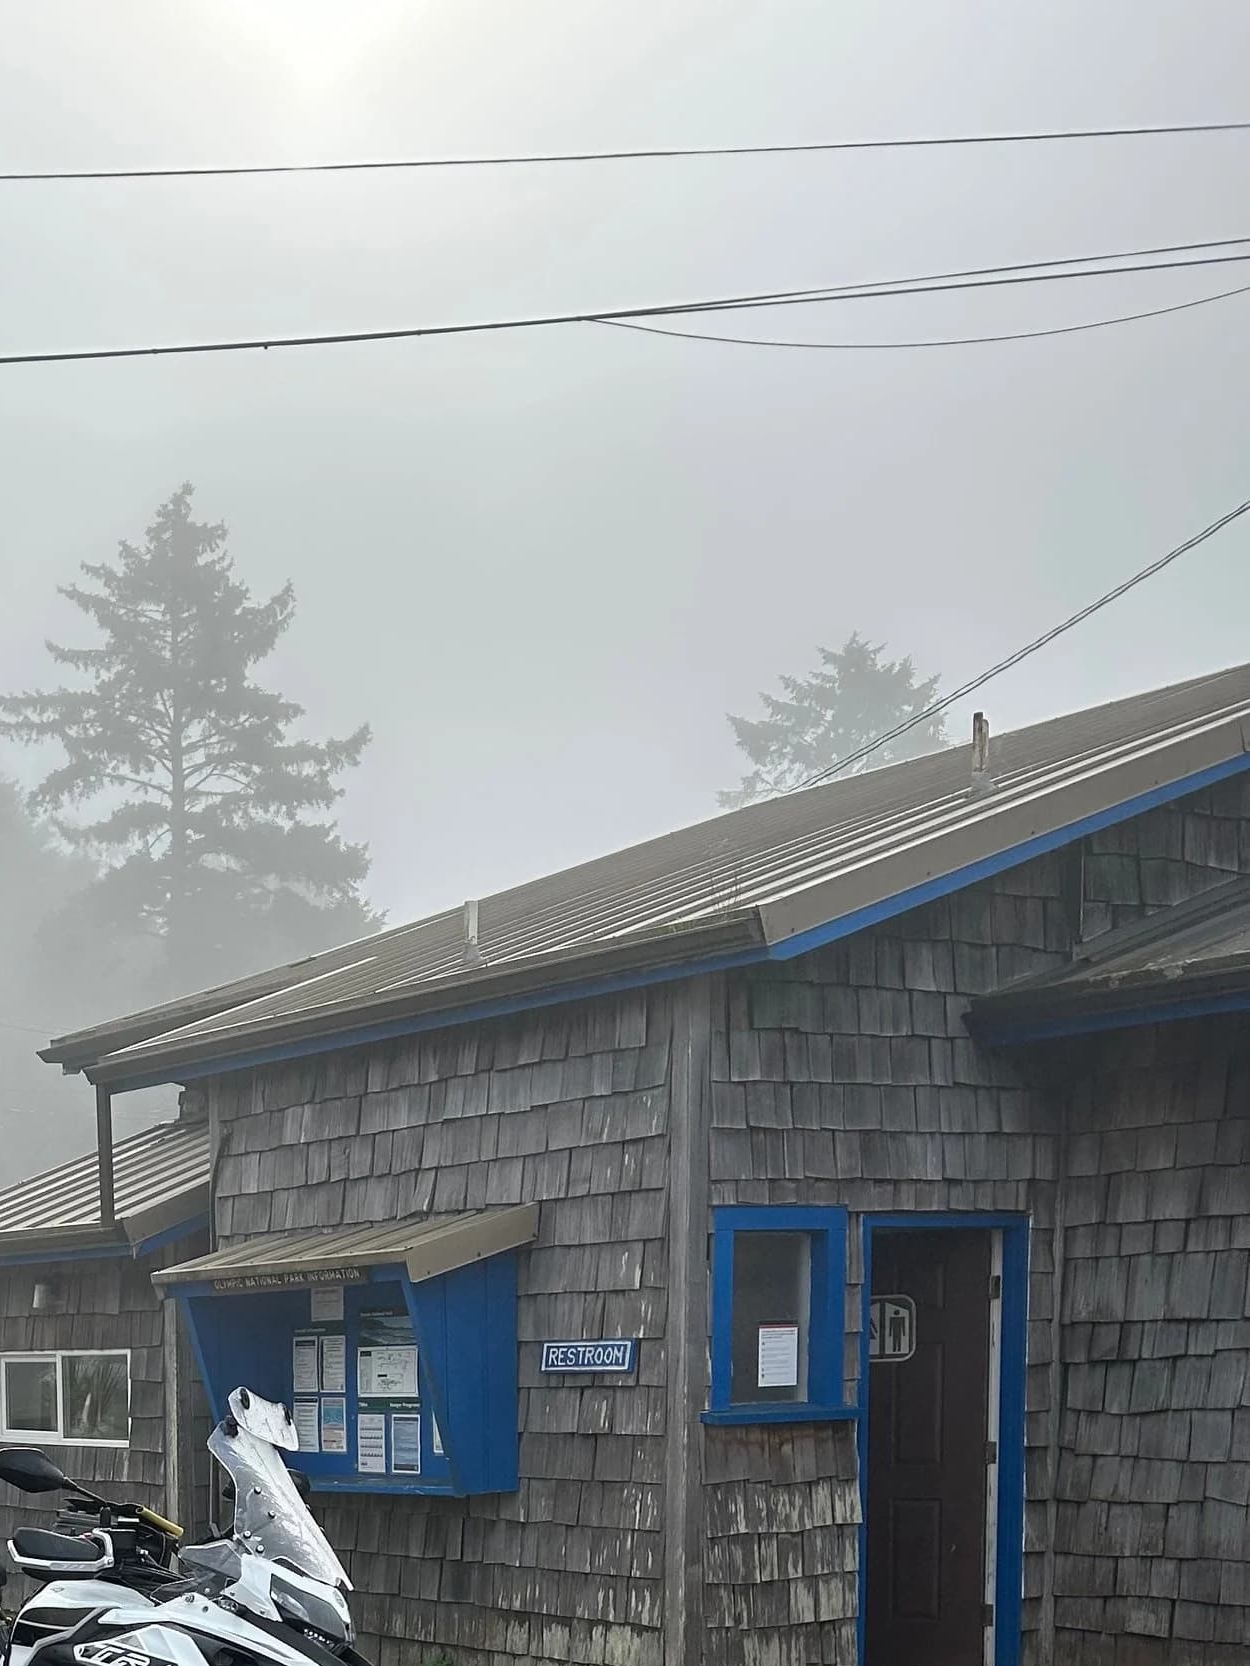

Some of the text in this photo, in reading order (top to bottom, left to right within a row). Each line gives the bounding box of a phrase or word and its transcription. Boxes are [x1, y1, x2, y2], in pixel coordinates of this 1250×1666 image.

[214, 1268, 360, 1290] OLYMPIC NATIONAL PARK INFORMATION
[548, 1345, 624, 1366] RESTROOM
